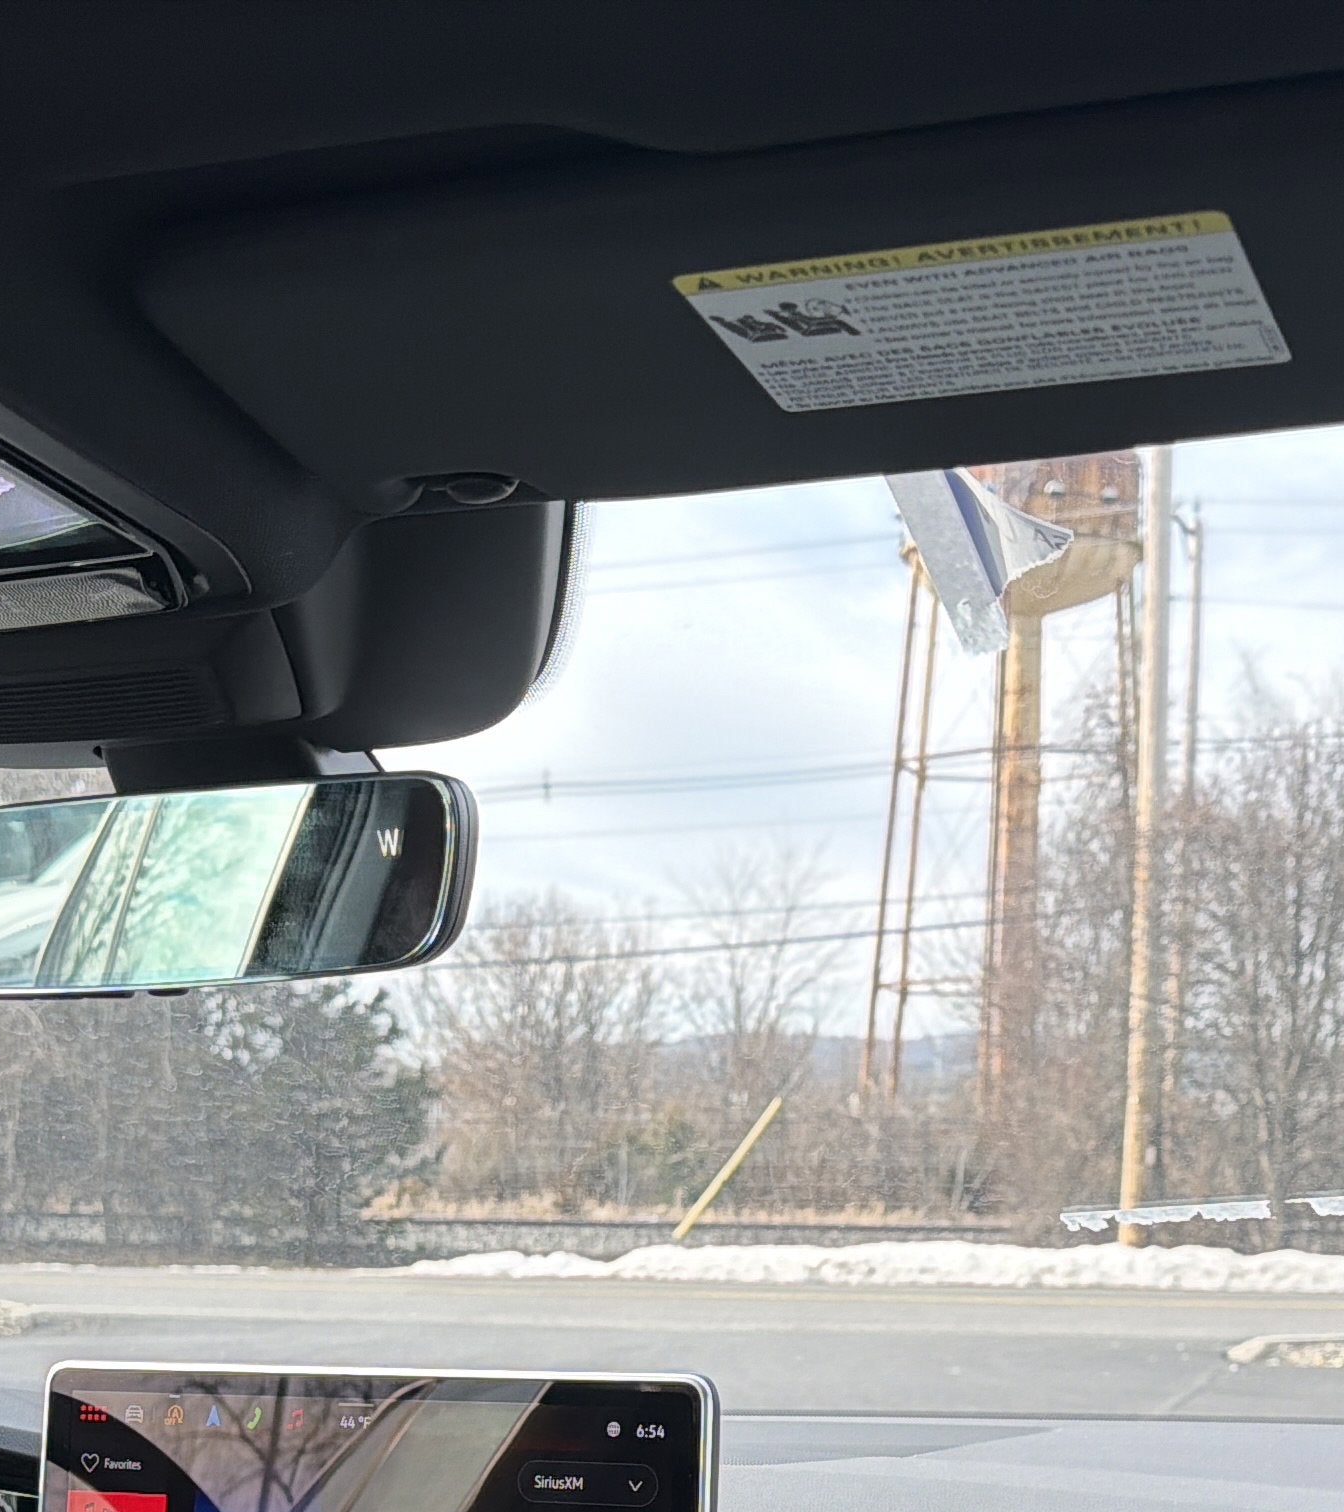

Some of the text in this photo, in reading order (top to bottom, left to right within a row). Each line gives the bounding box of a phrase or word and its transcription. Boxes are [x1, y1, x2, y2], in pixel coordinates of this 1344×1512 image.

[733, 218, 1203, 285] WARNING! AVERTISSEMENT!
[842, 277, 900, 291] EVEN
[900, 270, 960, 284] WITH
[961, 257, 1079, 277] ADVANCED
[376, 827, 399, 857] W
[339, 1416, 357, 1430] 44
[636, 1424, 665, 1439] 6:54
[104, 1458, 142, 1472] Favorites
[534, 1475, 584, 1491] SiriusXM
